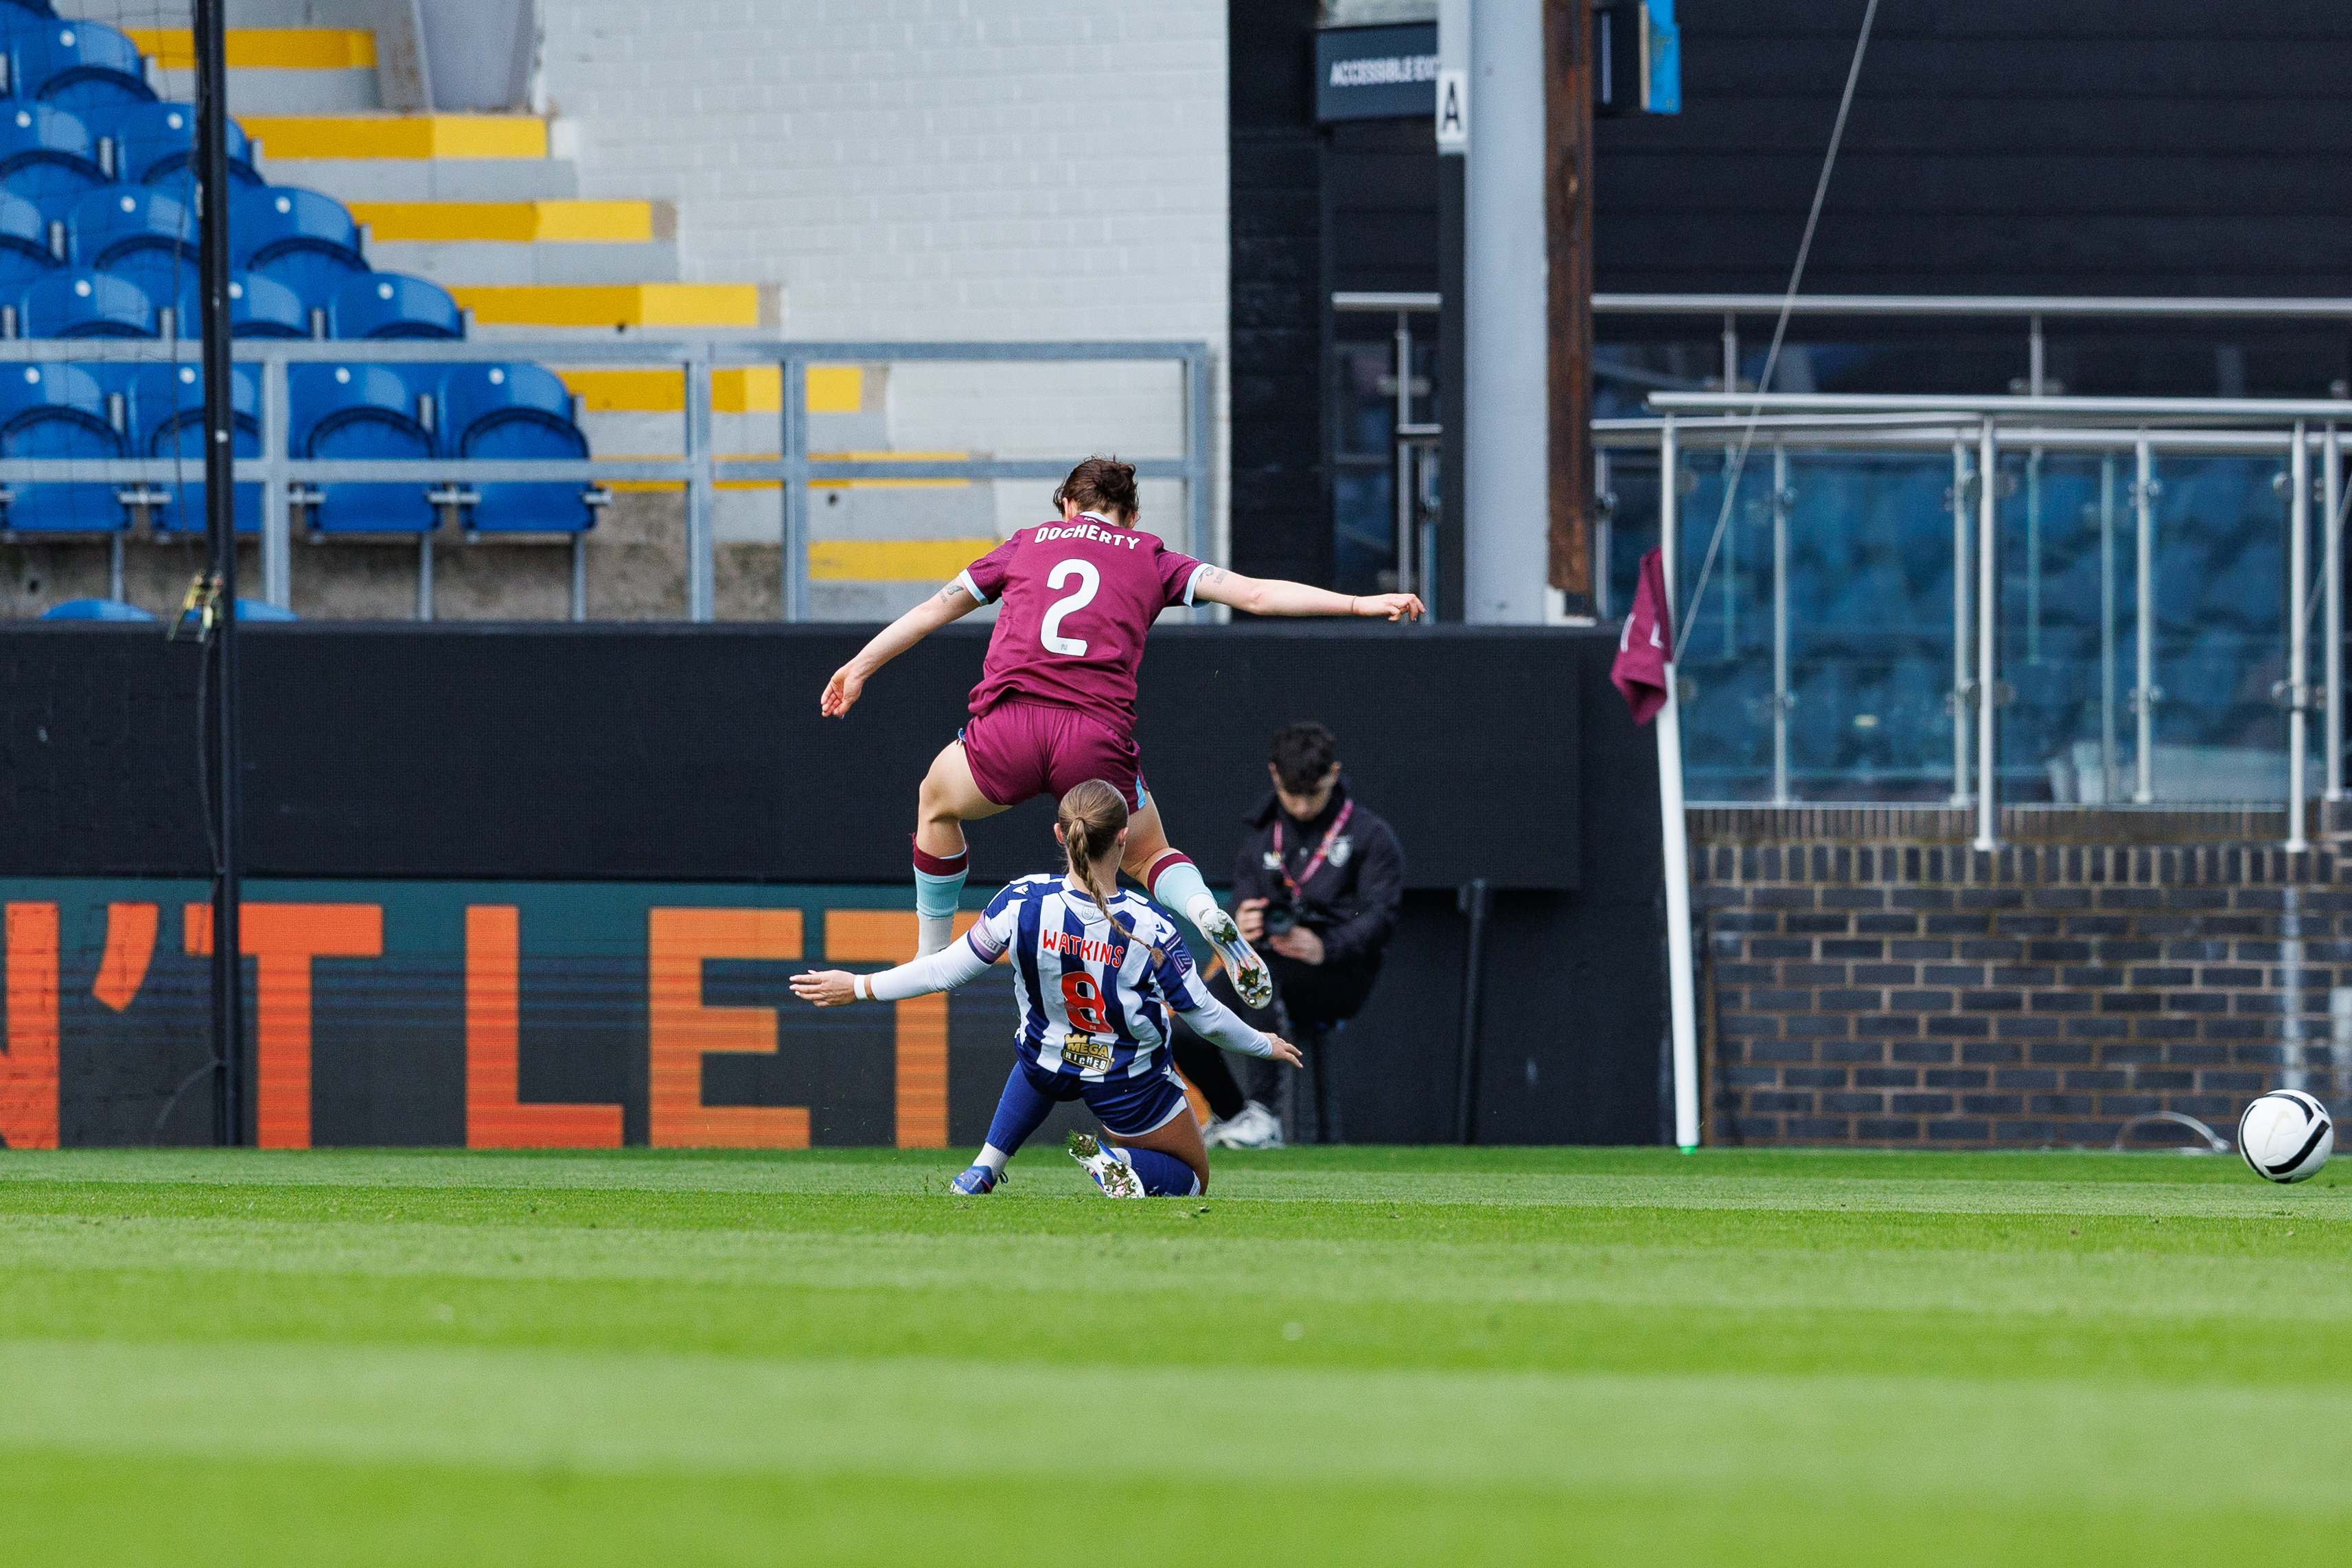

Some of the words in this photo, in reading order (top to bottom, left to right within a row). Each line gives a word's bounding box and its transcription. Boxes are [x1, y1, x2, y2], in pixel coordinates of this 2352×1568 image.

[1442, 81, 1462, 132] A
[1035, 524, 1140, 550] DOCHERTY
[1040, 558, 1100, 657] 2
[1043, 929, 1125, 968] WATKINS
[1061, 971, 1114, 1034] 8
[465, 905, 1009, 1149] LET
[1065, 1051, 1107, 1070] RICHES
[1067, 1043, 1109, 1058] MEGA
